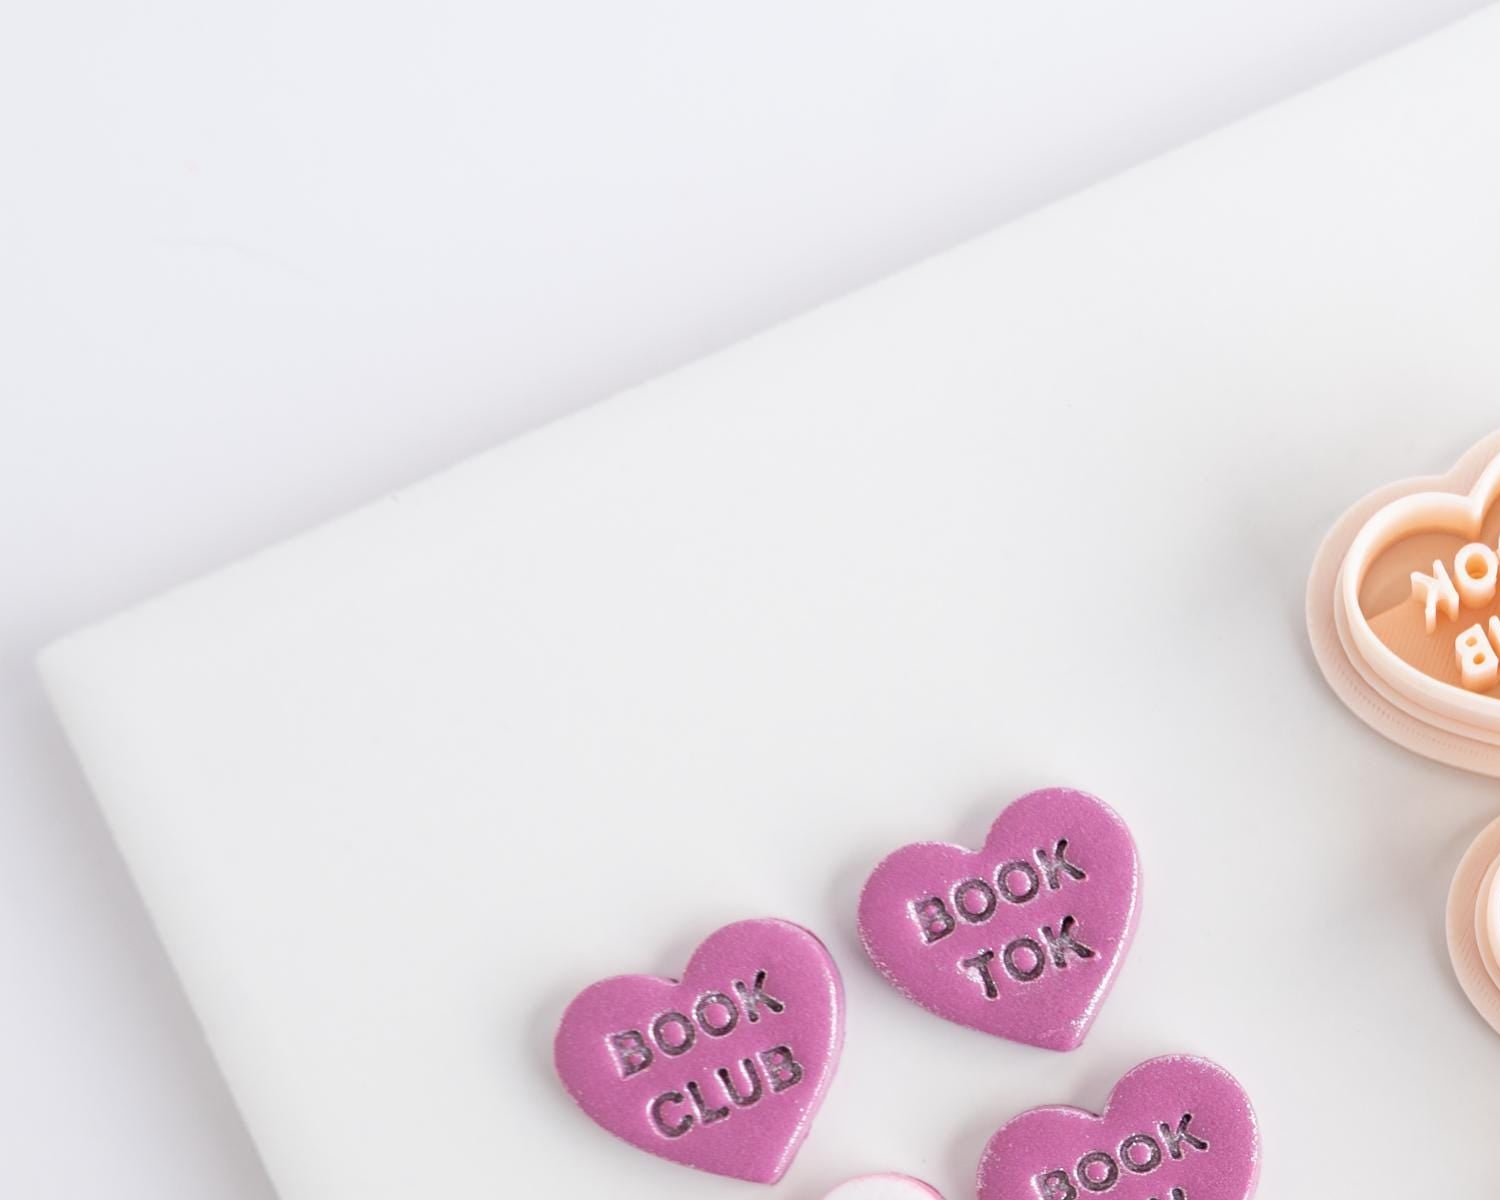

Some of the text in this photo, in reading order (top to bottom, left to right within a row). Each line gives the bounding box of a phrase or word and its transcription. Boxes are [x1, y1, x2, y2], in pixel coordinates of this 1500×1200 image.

[908, 838, 1088, 944] BOOK
[962, 916, 1096, 999] TOK
[605, 970, 784, 1080] BOOK
[646, 1044, 804, 1139] CLUB
